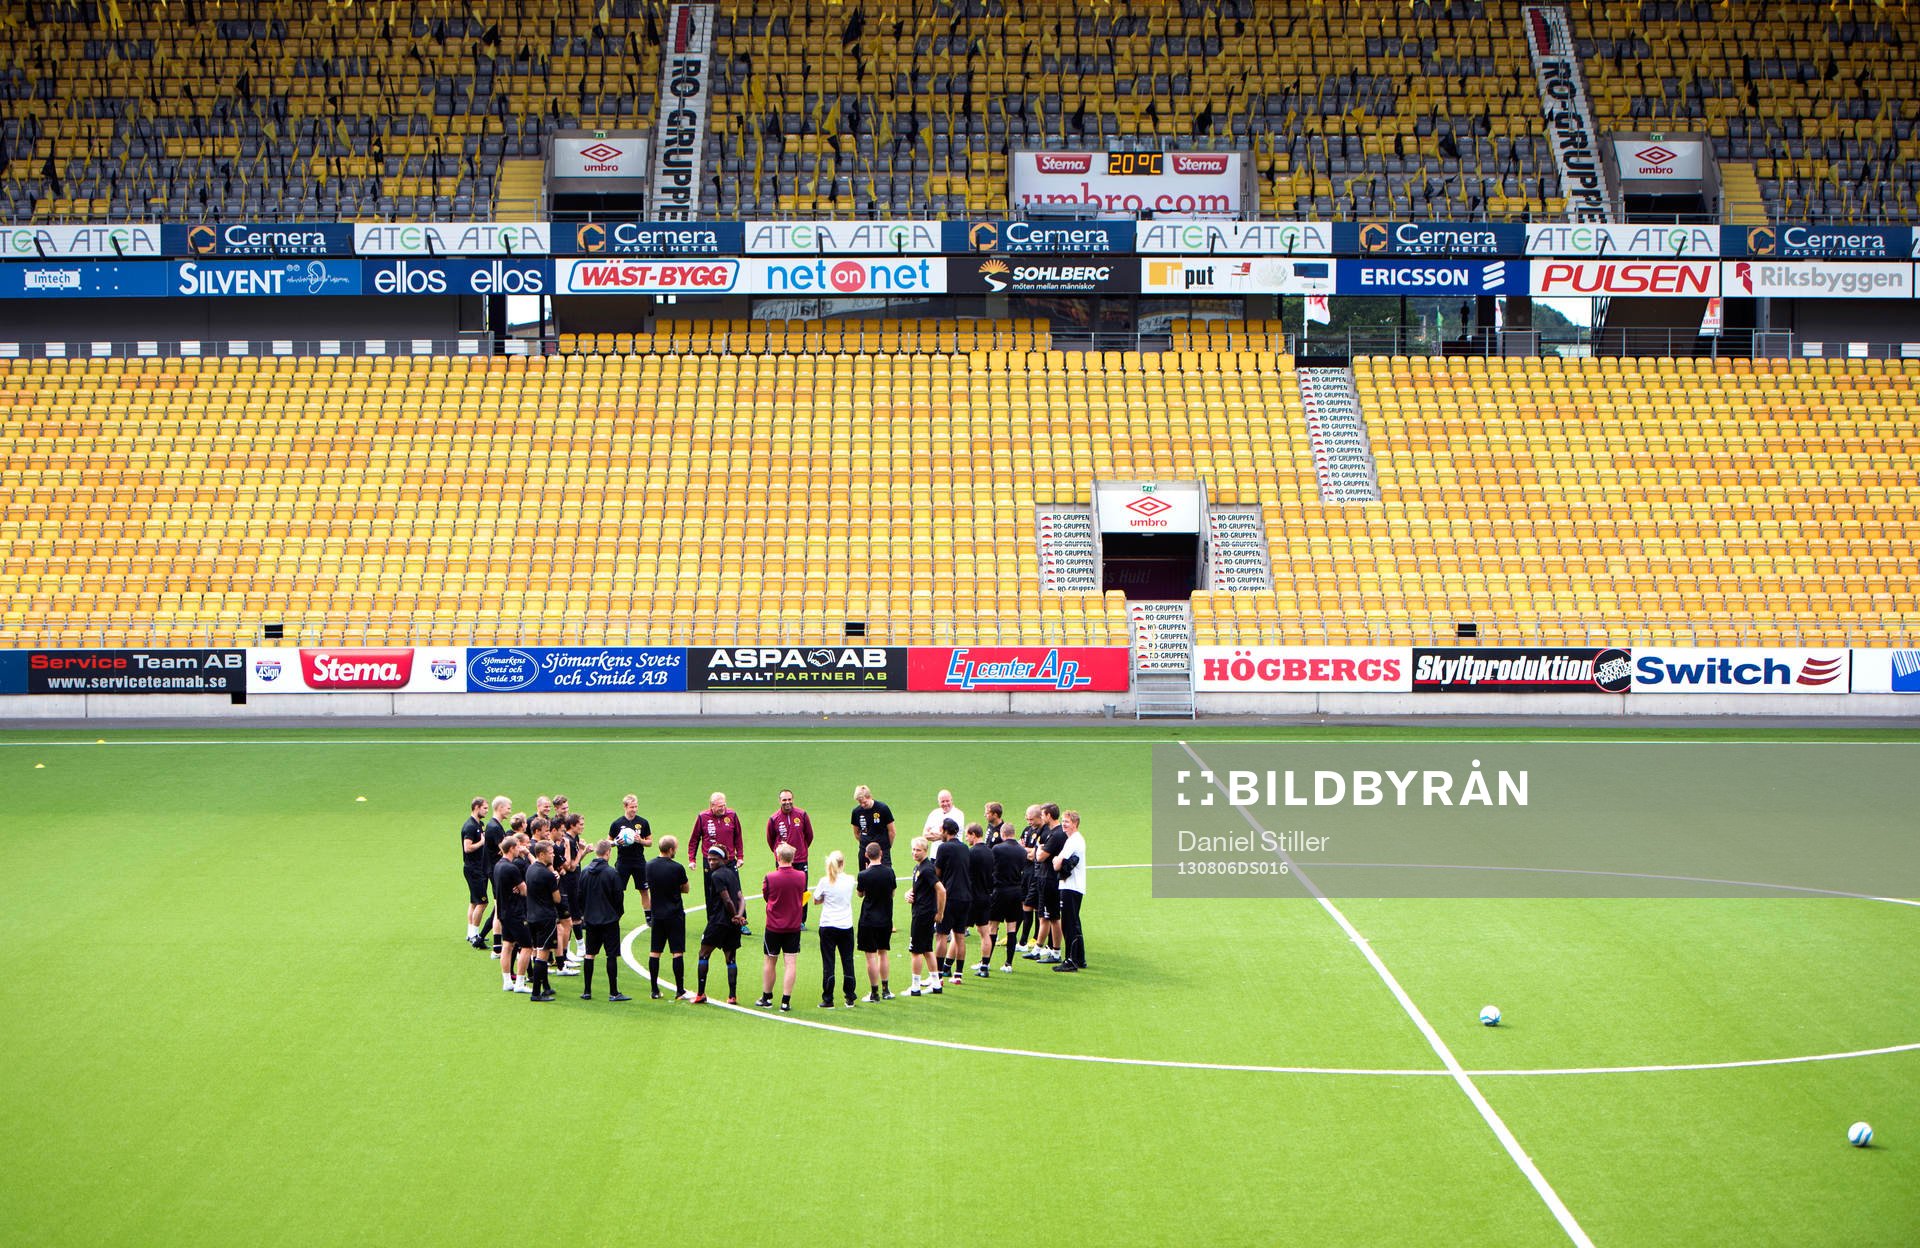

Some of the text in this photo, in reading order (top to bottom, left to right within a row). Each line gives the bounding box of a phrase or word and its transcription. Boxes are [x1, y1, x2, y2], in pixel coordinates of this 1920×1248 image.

[584, 163, 619, 172] umbro
[1639, 166, 1673, 174] umbro
[1022, 182, 1232, 215] umbro.com
[224, 225, 327, 246] Cernera
[360, 226, 544, 250] ATEA ATEA
[614, 223, 719, 244] Cernera
[751, 225, 935, 249] ATEA ATEA
[1006, 222, 1109, 243] Cernera
[1142, 225, 1326, 249] ATEA ATEA
[1395, 223, 1497, 245] Cernera
[1532, 228, 1713, 252] ATEA ATEA
[1784, 227, 1886, 248] Cernera
[34, 273, 71, 284] Imtech
[179, 262, 285, 295] SILVENT
[374, 260, 543, 294] ellos ellos
[581, 259, 729, 287] WÄST-BYGG
[1012, 266, 1110, 281] SOHLBERG
[1361, 268, 1469, 286] ERICSSON
[1541, 264, 1712, 293] PULSEN
[1761, 266, 1903, 293] Riksbyggen
[1036, 282, 1059, 290] mellan
[1060, 282, 1096, 290] människor
[1130, 518, 1168, 527] umbro
[31, 654, 243, 669] Service Team AB
[541, 651, 680, 673] Sjömarkens Svets
[708, 649, 887, 668] ASPA AB
[1203, 650, 1400, 681] HÖGBERGS
[554, 669, 668, 686] och Smide AB
[708, 673, 887, 681] ASFALTPARTNER AB
[1415, 655, 1593, 684] Skyltproduktion
[1636, 656, 1791, 684] Switch
[48, 675, 227, 689] www.serviceteamab.se
